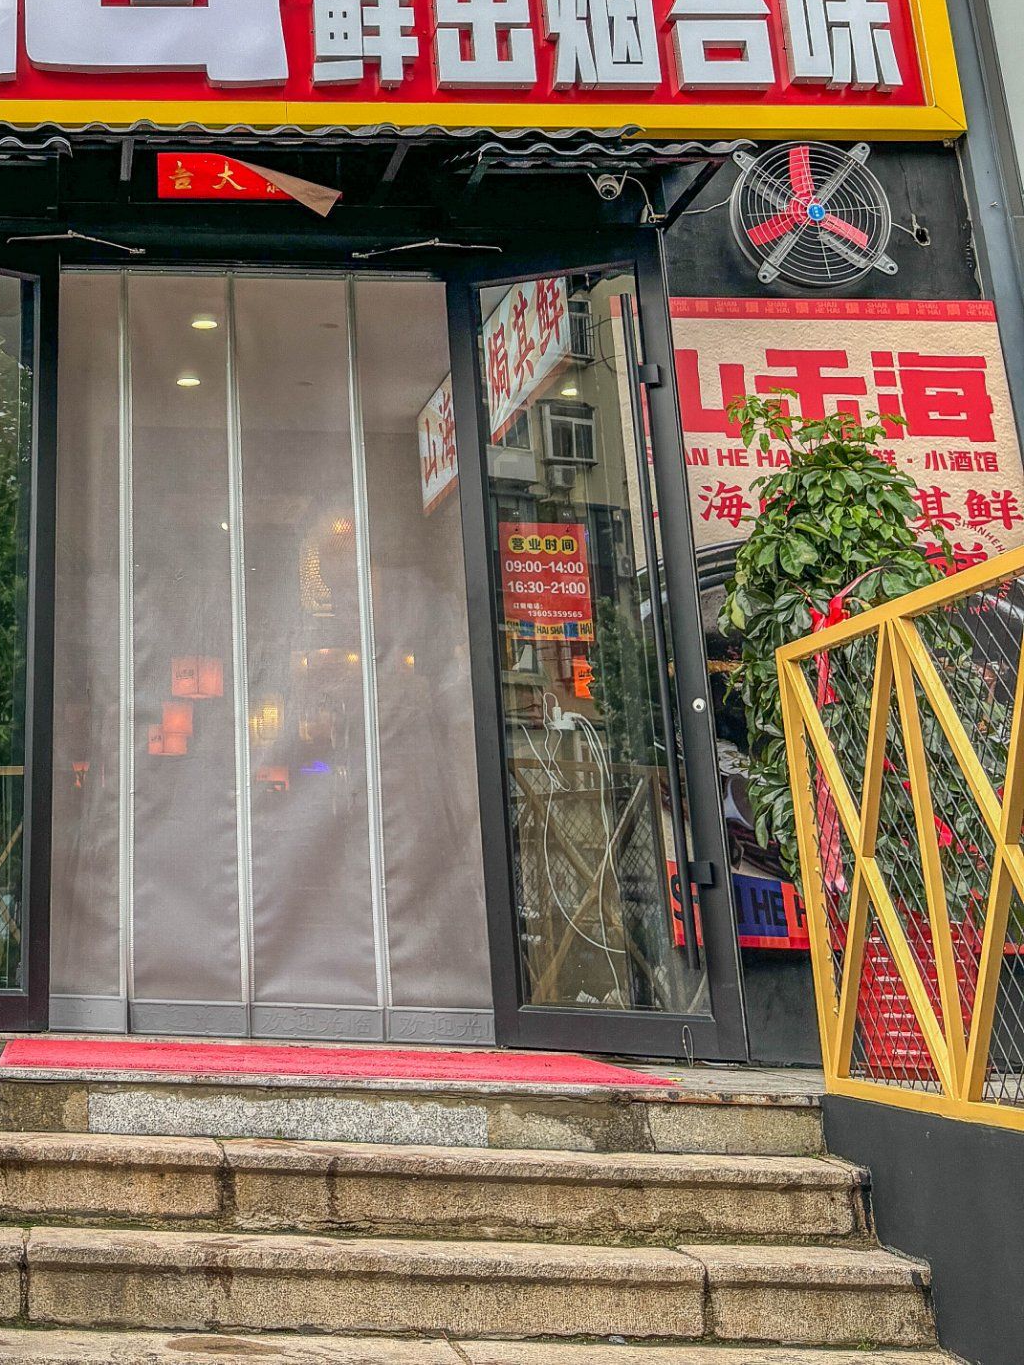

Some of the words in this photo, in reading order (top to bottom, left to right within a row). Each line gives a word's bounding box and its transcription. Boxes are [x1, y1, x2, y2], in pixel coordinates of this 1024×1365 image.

[717, 449, 749, 466] HE
[756, 449, 792, 467] HA
[699, 481, 751, 528] 海
[511, 537, 575, 551] 营业时间
[505, 560, 584, 574] 09:00-14:00
[507, 581, 586, 594] 16:30-21:00
